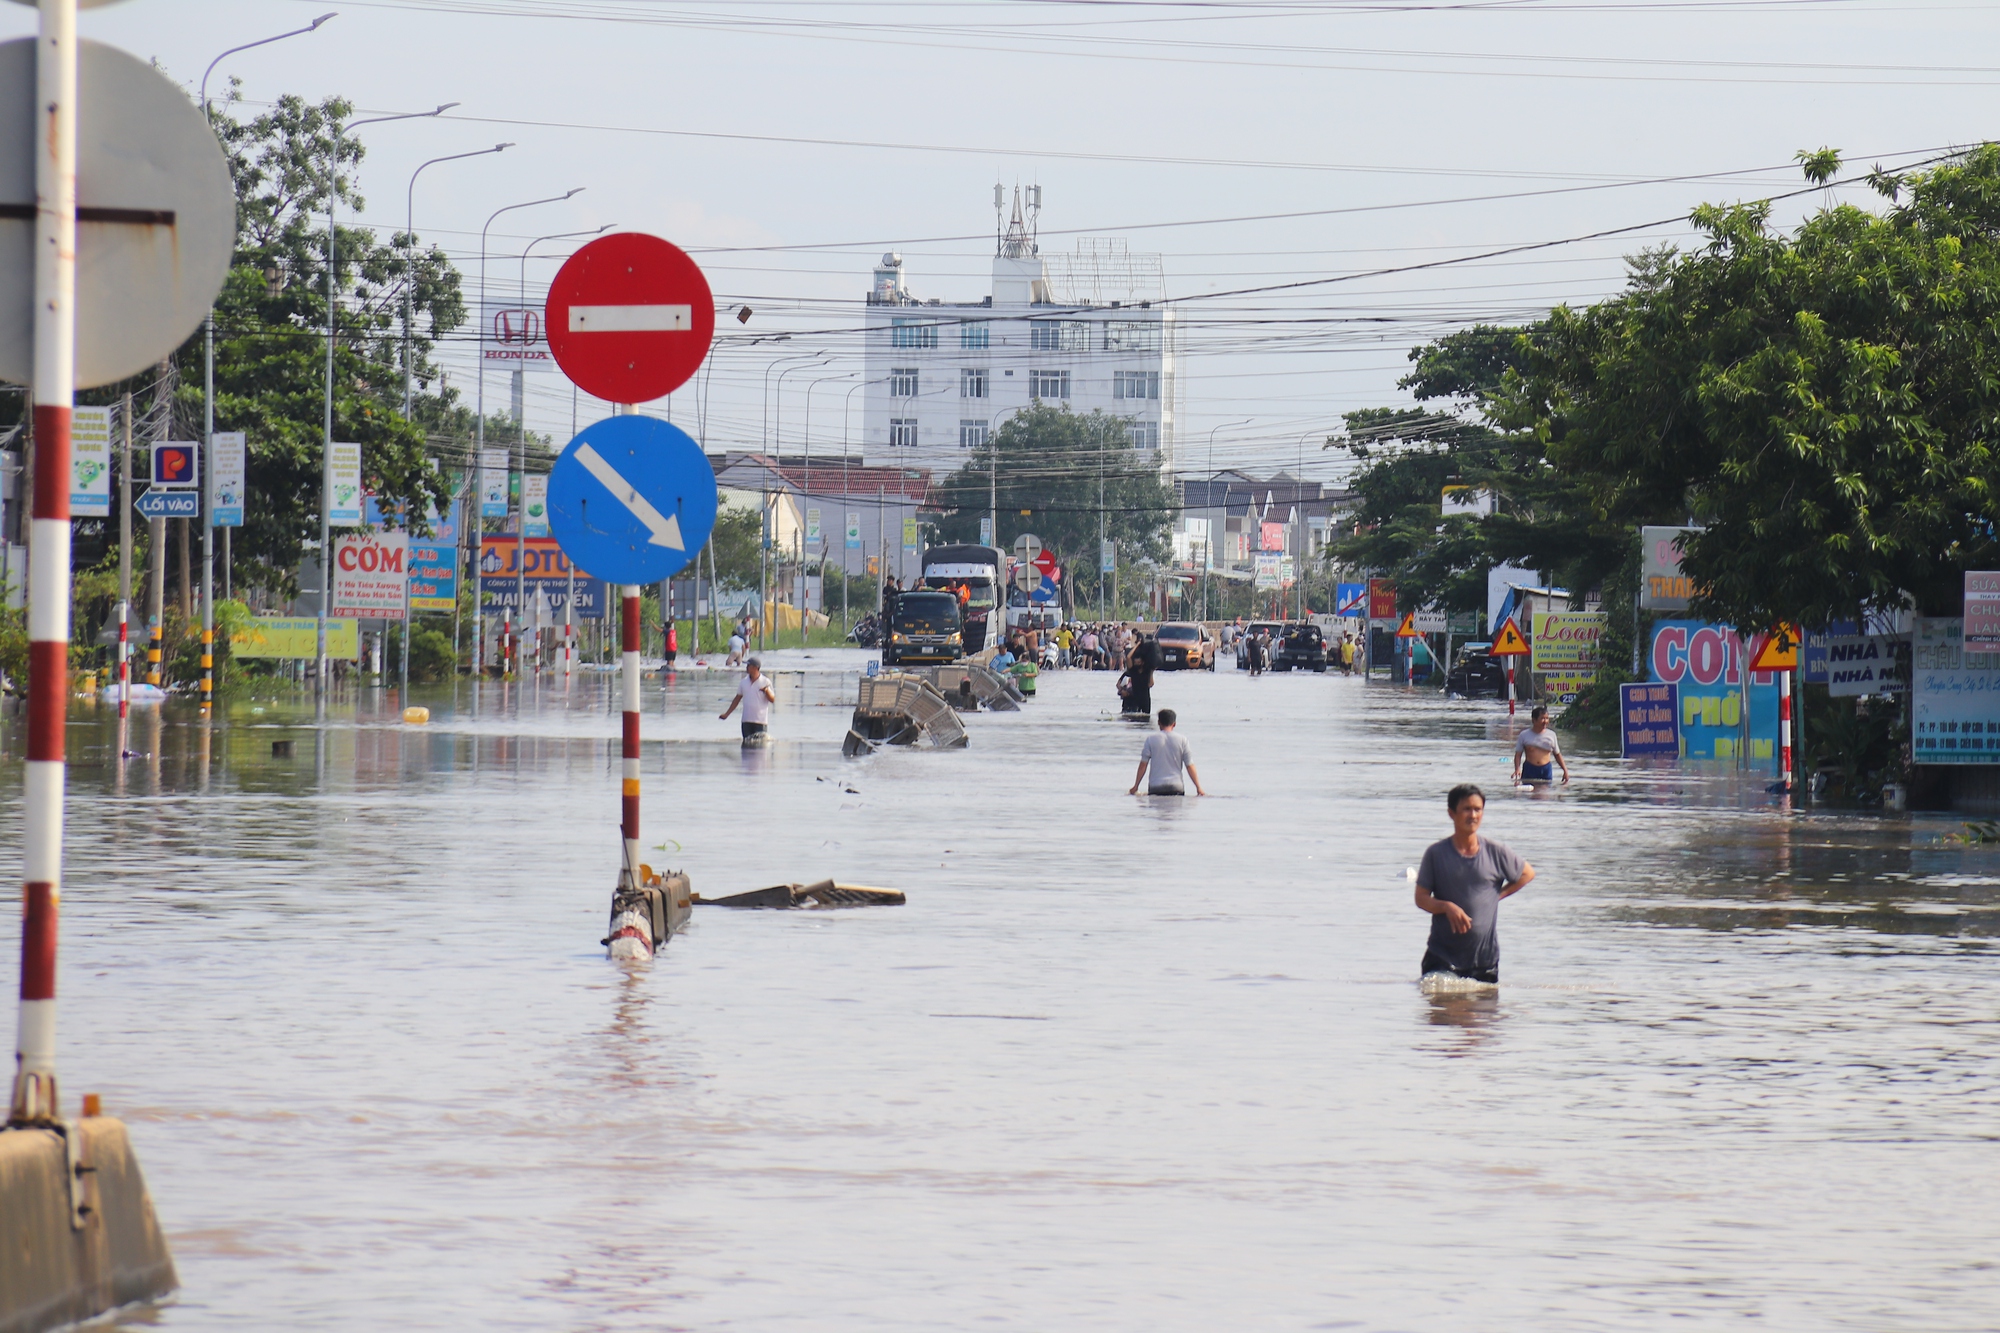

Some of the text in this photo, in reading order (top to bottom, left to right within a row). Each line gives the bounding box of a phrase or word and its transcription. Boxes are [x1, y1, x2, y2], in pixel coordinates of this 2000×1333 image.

[484, 350, 549, 360] HONDA
[143, 496, 194, 511] LỐI VÀO
[338, 542, 404, 573] CƠM
[506, 548, 581, 573] JOTU
[1972, 576, 1999, 591] SỬA
[1377, 602, 1390, 615] TÂY
[1536, 615, 1599, 642] Loan
[1653, 625, 1774, 686] CƠM
[1830, 638, 1879, 662] NHÀ
[1917, 642, 1960, 670] CHÂU
[1832, 666, 1874, 683] NHÀ
[1629, 684, 1670, 702] CHO THUÊ
[1628, 706, 1647, 726] MẶT
[1656, 727, 1675, 743] NHÀ
